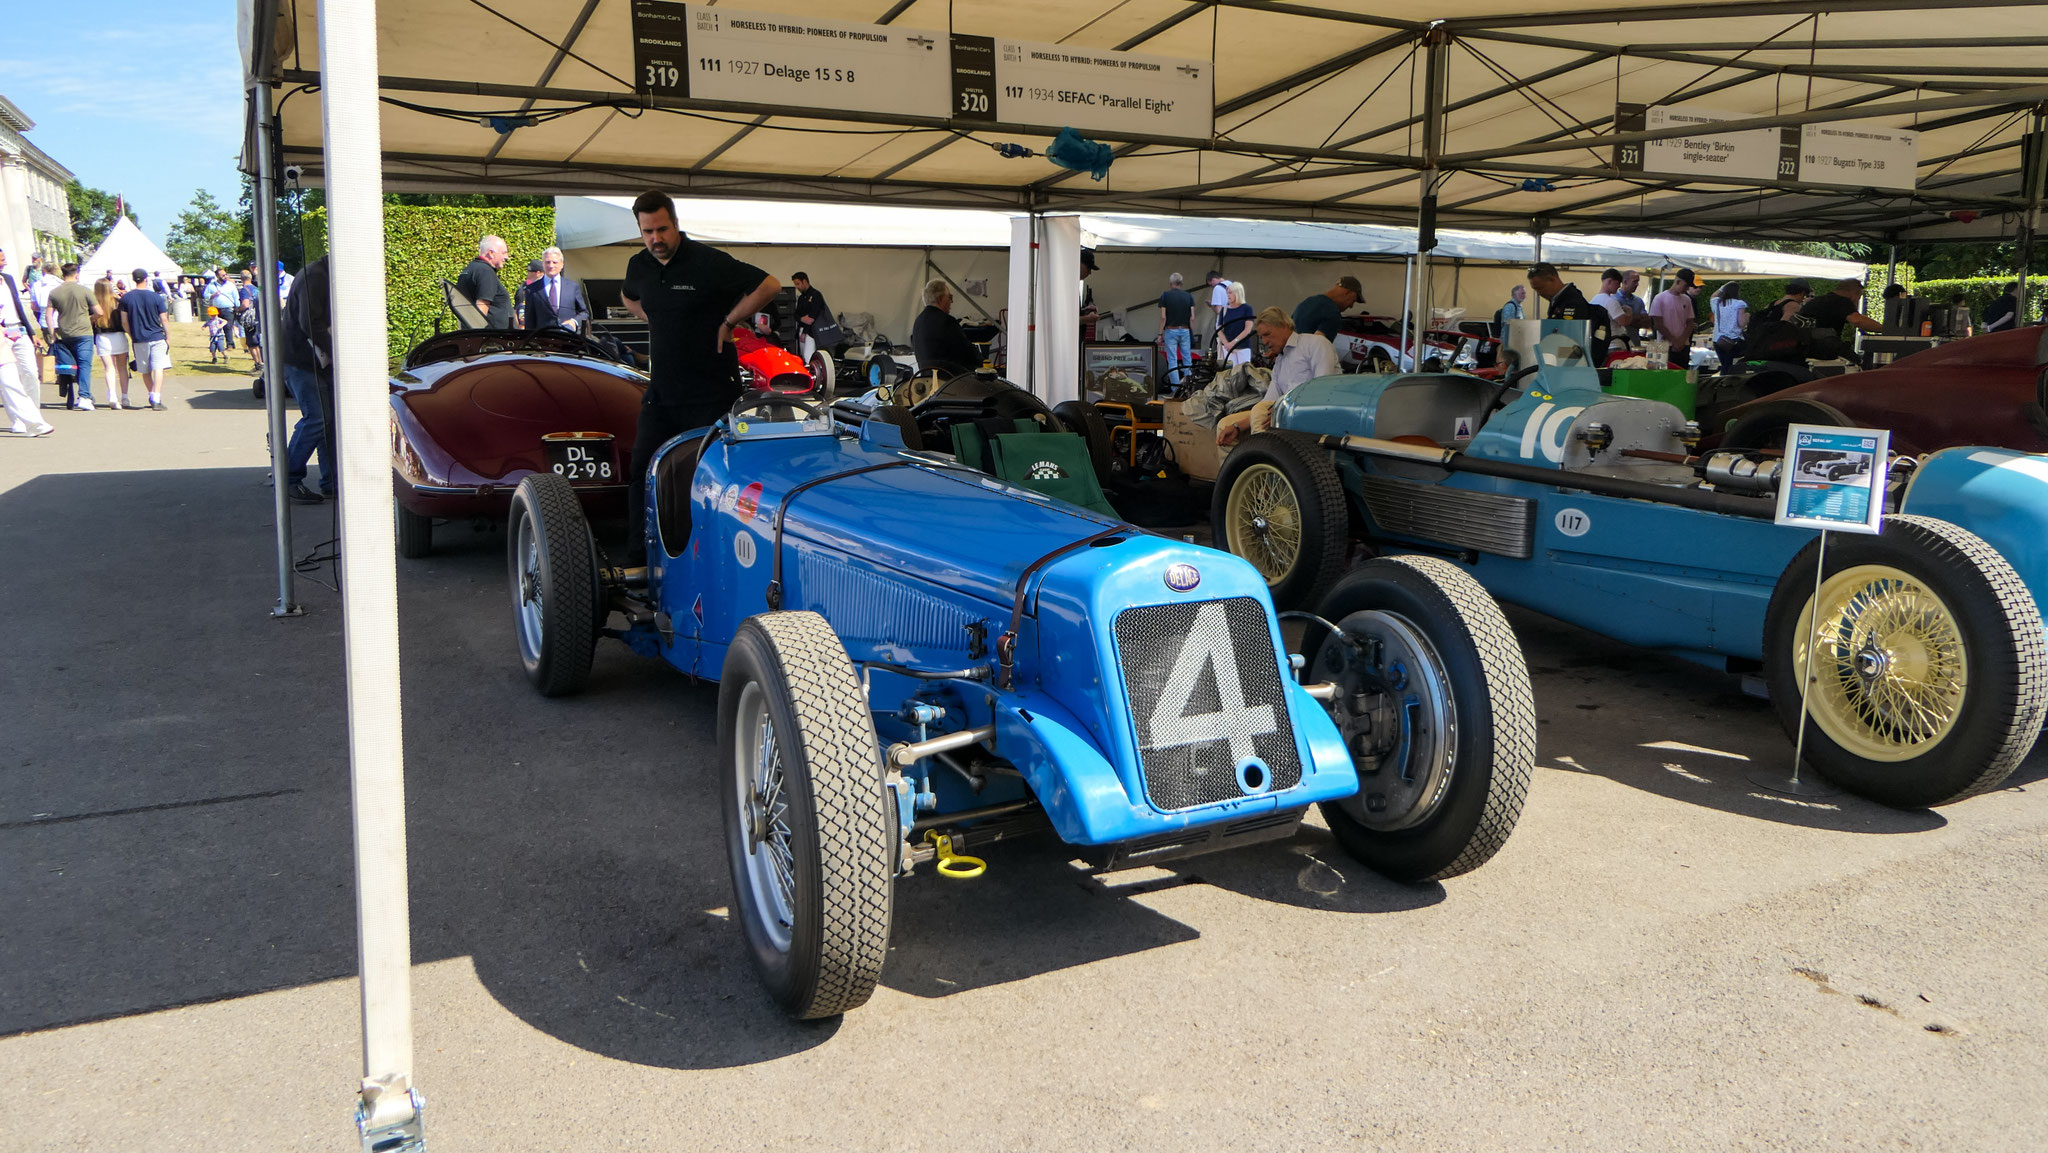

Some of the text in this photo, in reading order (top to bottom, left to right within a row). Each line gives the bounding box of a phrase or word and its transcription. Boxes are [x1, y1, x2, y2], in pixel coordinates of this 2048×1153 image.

[696, 12, 711, 21] CLASS
[697, 22, 719, 32] BATCH 1
[731, 20, 888, 43] HORSELESS TO HYBRID: PIONEERS OF PROPULSION
[640, 38, 682, 47] BROOKLANDS
[1031, 51, 1160, 72] HORSELESS TO HYBRID: PIONEERS OF PROPULSION
[645, 65, 679, 87] 319
[700, 58, 855, 83] 111 1927 Delage 15 S 8
[961, 93, 988, 112] 320
[1005, 86, 1024, 99] 117
[1029, 87, 1054, 101] 1934
[1057, 90, 1096, 105] SEFAC
[1684, 139, 1711, 152] Bentley
[1621, 149, 1639, 165] 321
[1805, 155, 1816, 164] 110
[1817, 155, 1832, 166] 1927
[1833, 156, 1855, 169] Bugatti
[1858, 158, 1872, 170] Type
[1873, 160, 1885, 170] 35B
[1779, 161, 1795, 175] 322
[567, 446, 594, 461] DL
[553, 462, 612, 479] 92-98
[1562, 514, 1583, 530] 117
[738, 538, 750, 560] 111
[1169, 567, 1199, 587] DELAGE
[1149, 603, 1278, 765] 4
